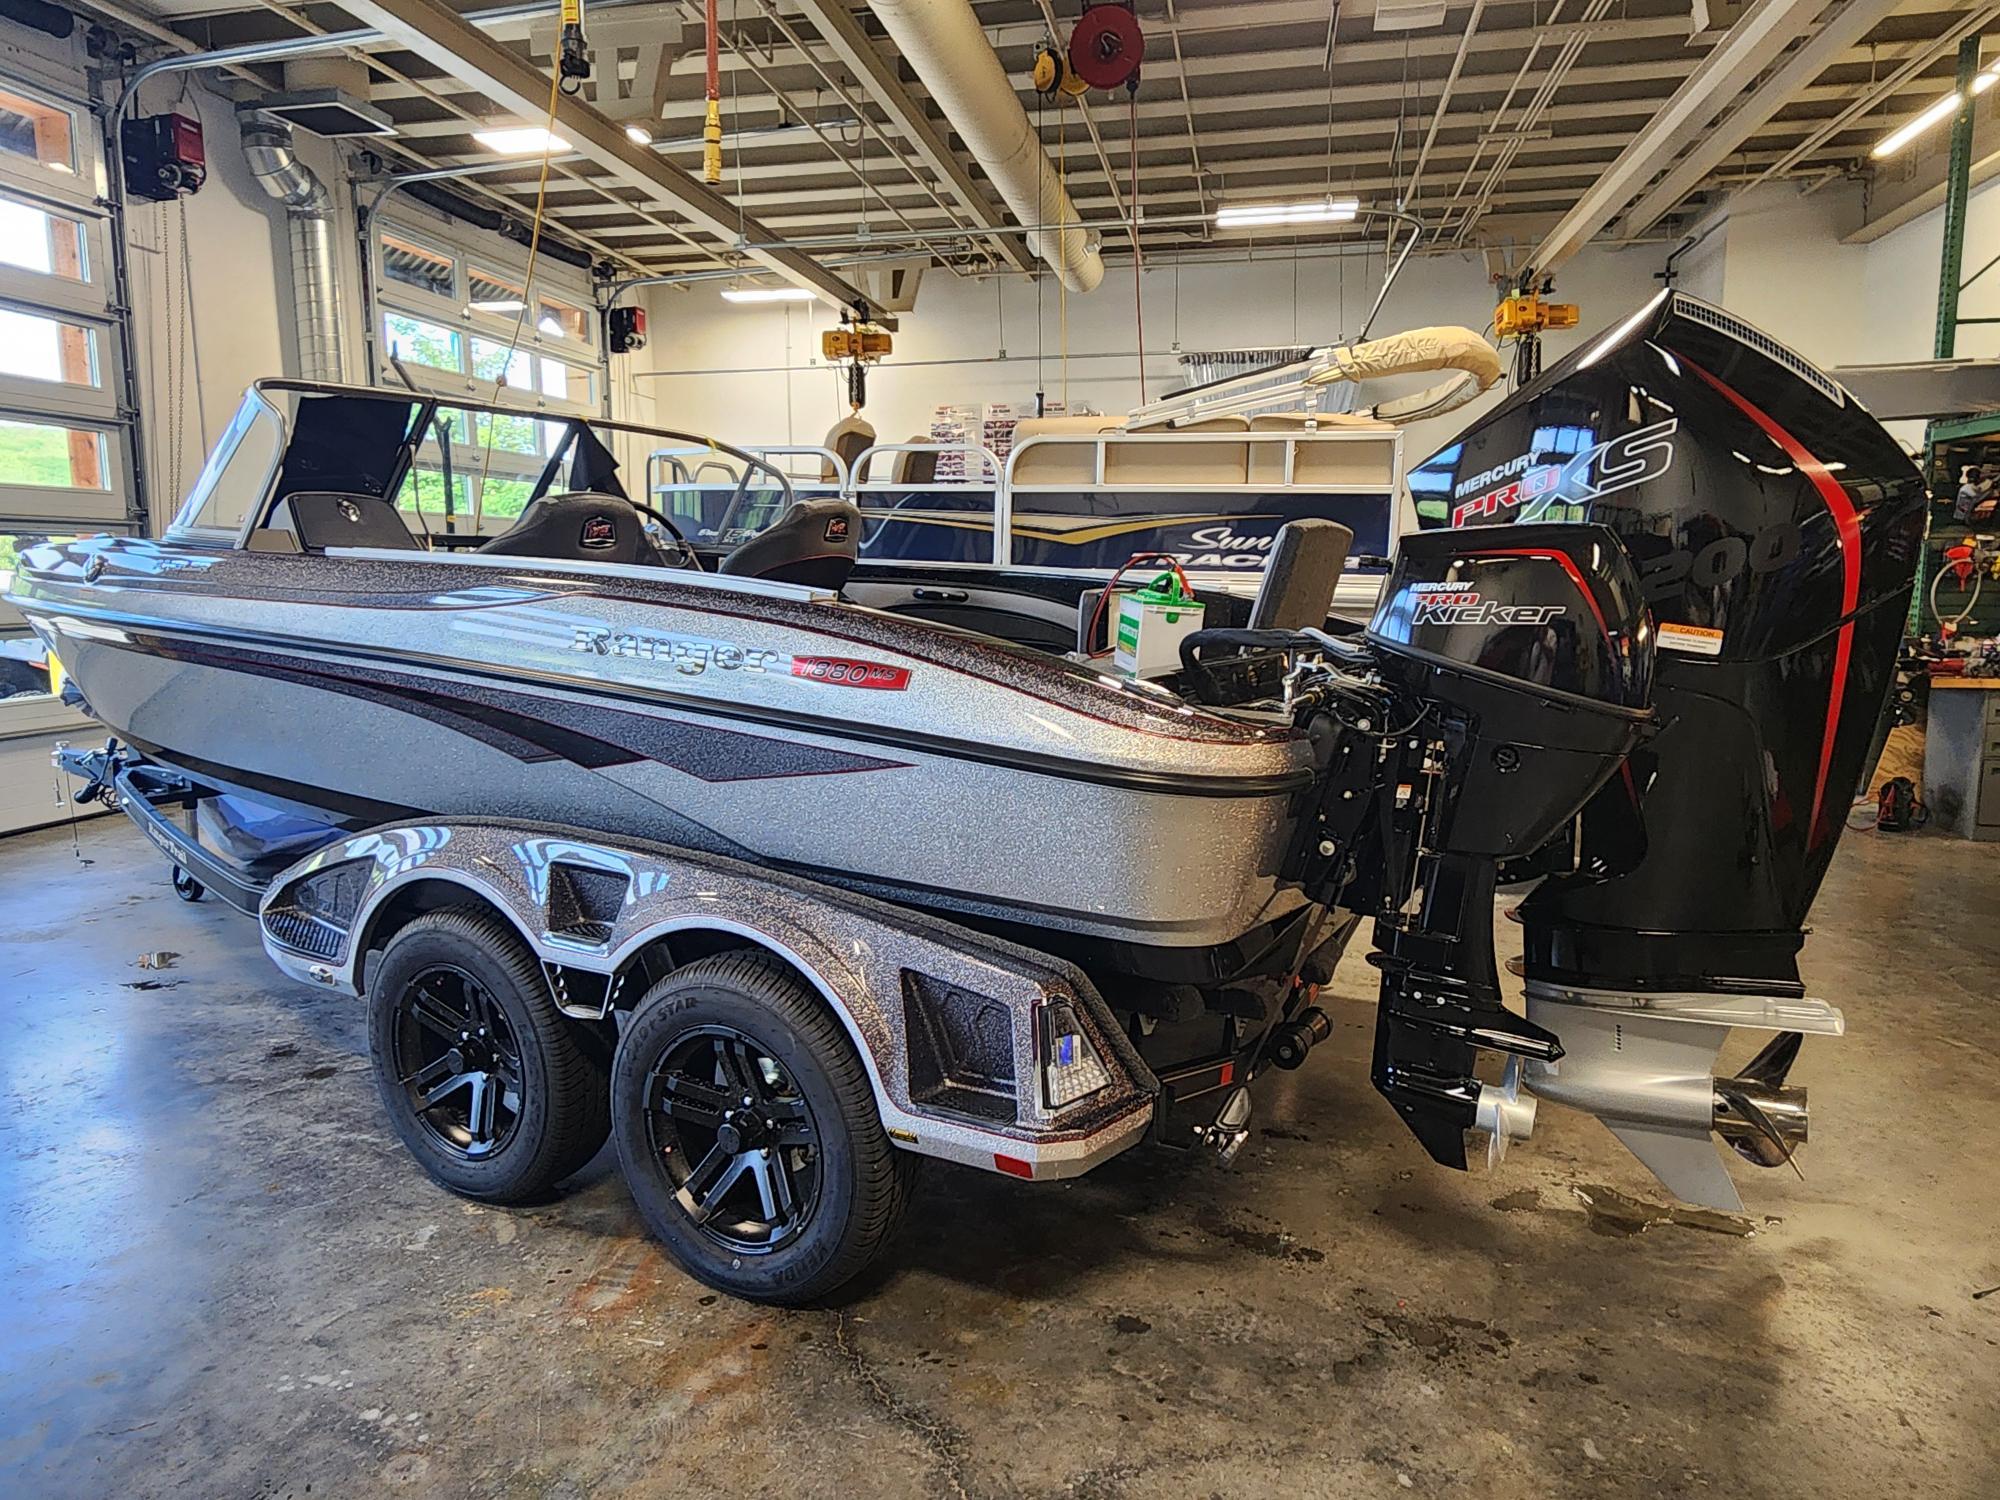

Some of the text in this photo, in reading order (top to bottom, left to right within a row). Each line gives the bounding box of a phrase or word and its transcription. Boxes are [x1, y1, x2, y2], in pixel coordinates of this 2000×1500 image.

[1455, 450, 1542, 499] MERCURY
[1451, 464, 1562, 529] PRO
[1177, 527, 1272, 551] Sun
[1409, 581, 1475, 592] MERCURY
[1411, 592, 1481, 607] PRO
[1411, 600, 1567, 626] Kicker
[1679, 627, 1716, 638] CAUTION
[568, 625, 780, 676] Ranger
